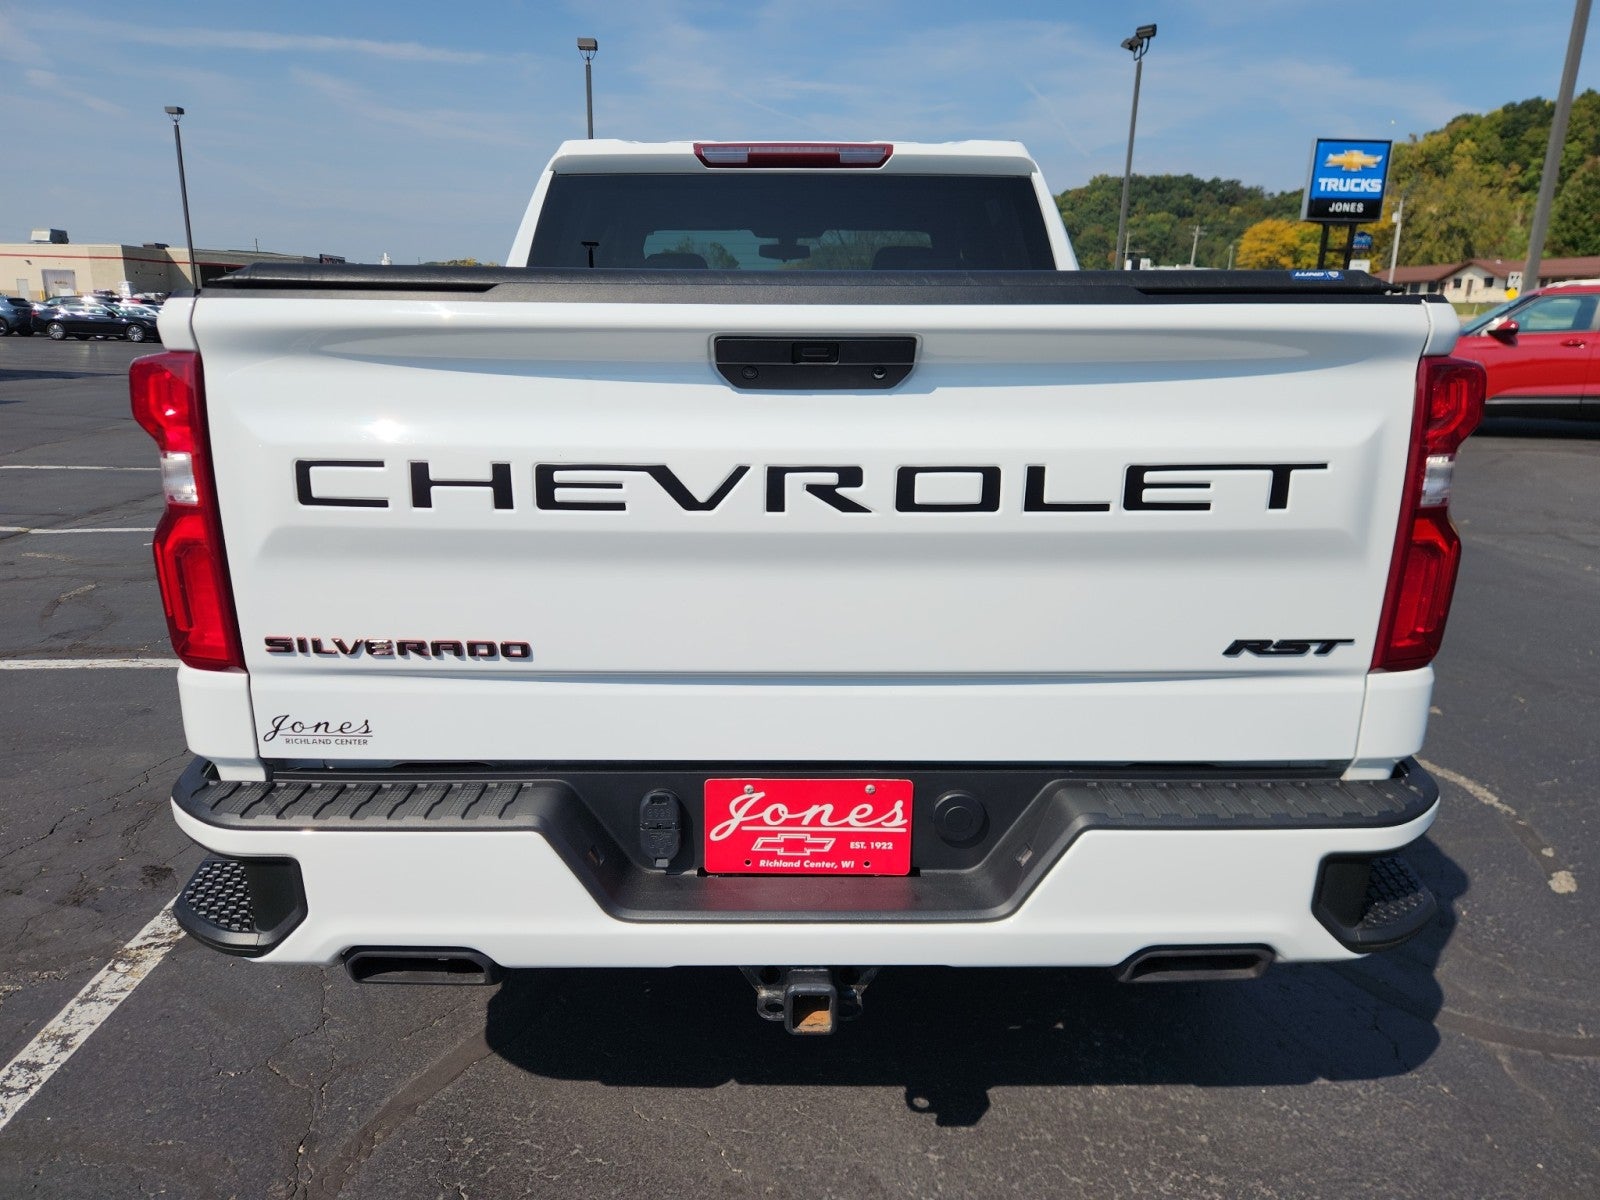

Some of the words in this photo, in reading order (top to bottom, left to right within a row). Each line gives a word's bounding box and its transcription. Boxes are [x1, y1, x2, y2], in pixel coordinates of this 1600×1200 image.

[1318, 177, 1382, 192] TRUCKS
[1328, 202, 1364, 213] JONES
[296, 460, 1328, 513] CHEVROLET
[264, 637, 532, 659] SILVERADO
[1222, 638, 1355, 656] RST
[264, 714, 373, 742] Jones
[334, 738, 368, 746] CENTER
[709, 791, 908, 842] Jones
[849, 841, 867, 850] EST.
[870, 841, 893, 850] 1922
[759, 859, 800, 868] Richland
[803, 860, 838, 869] Center,
[841, 860, 855, 869] WI
